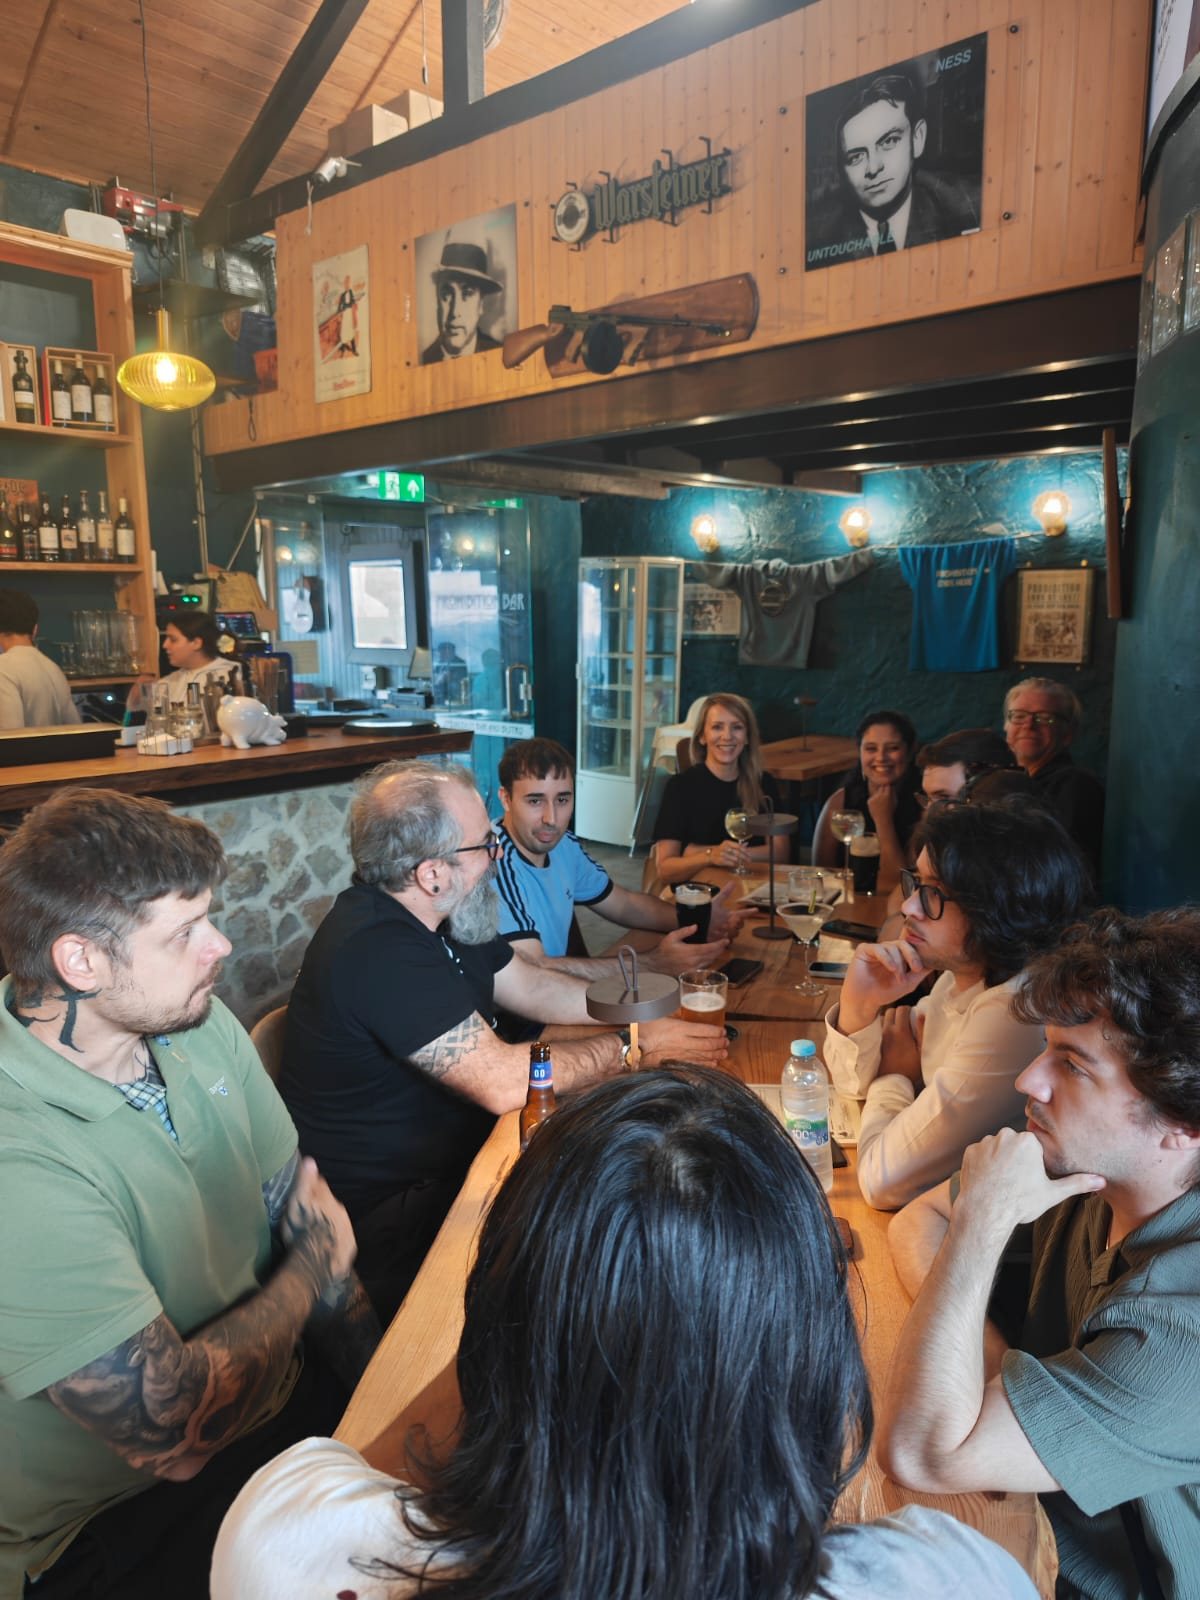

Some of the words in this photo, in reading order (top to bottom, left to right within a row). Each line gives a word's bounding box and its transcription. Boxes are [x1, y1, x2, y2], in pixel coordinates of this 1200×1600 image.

[935, 48, 972, 73] NESS
[595, 158, 721, 229] Warsteiner
[807, 230, 896, 262] UNTOUCHALE
[502, 593, 525, 610] BAR
